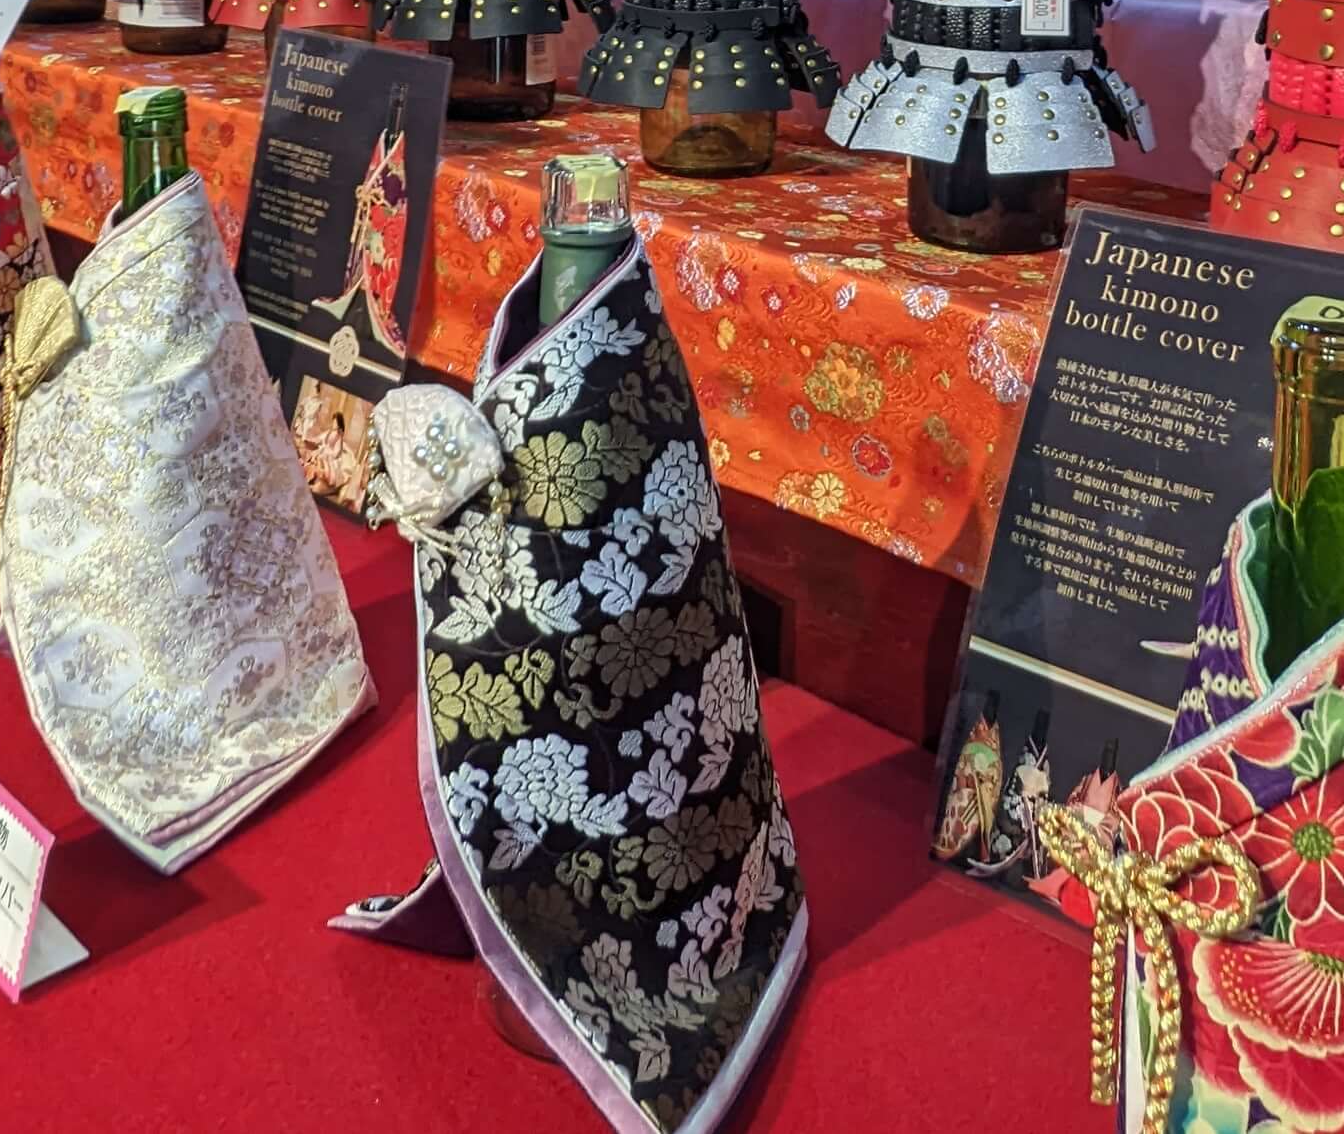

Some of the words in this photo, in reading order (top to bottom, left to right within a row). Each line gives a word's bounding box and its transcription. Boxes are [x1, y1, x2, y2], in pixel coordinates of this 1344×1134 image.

[281, 42, 349, 78] Japanese
[270, 89, 306, 114] bottle
[307, 102, 344, 124] cover
[285, 71, 334, 99] kimono
[1084, 229, 1256, 292] Japanese
[1099, 274, 1220, 324] kimono
[1063, 300, 1149, 343] bottle
[1157, 326, 1246, 365] cover
